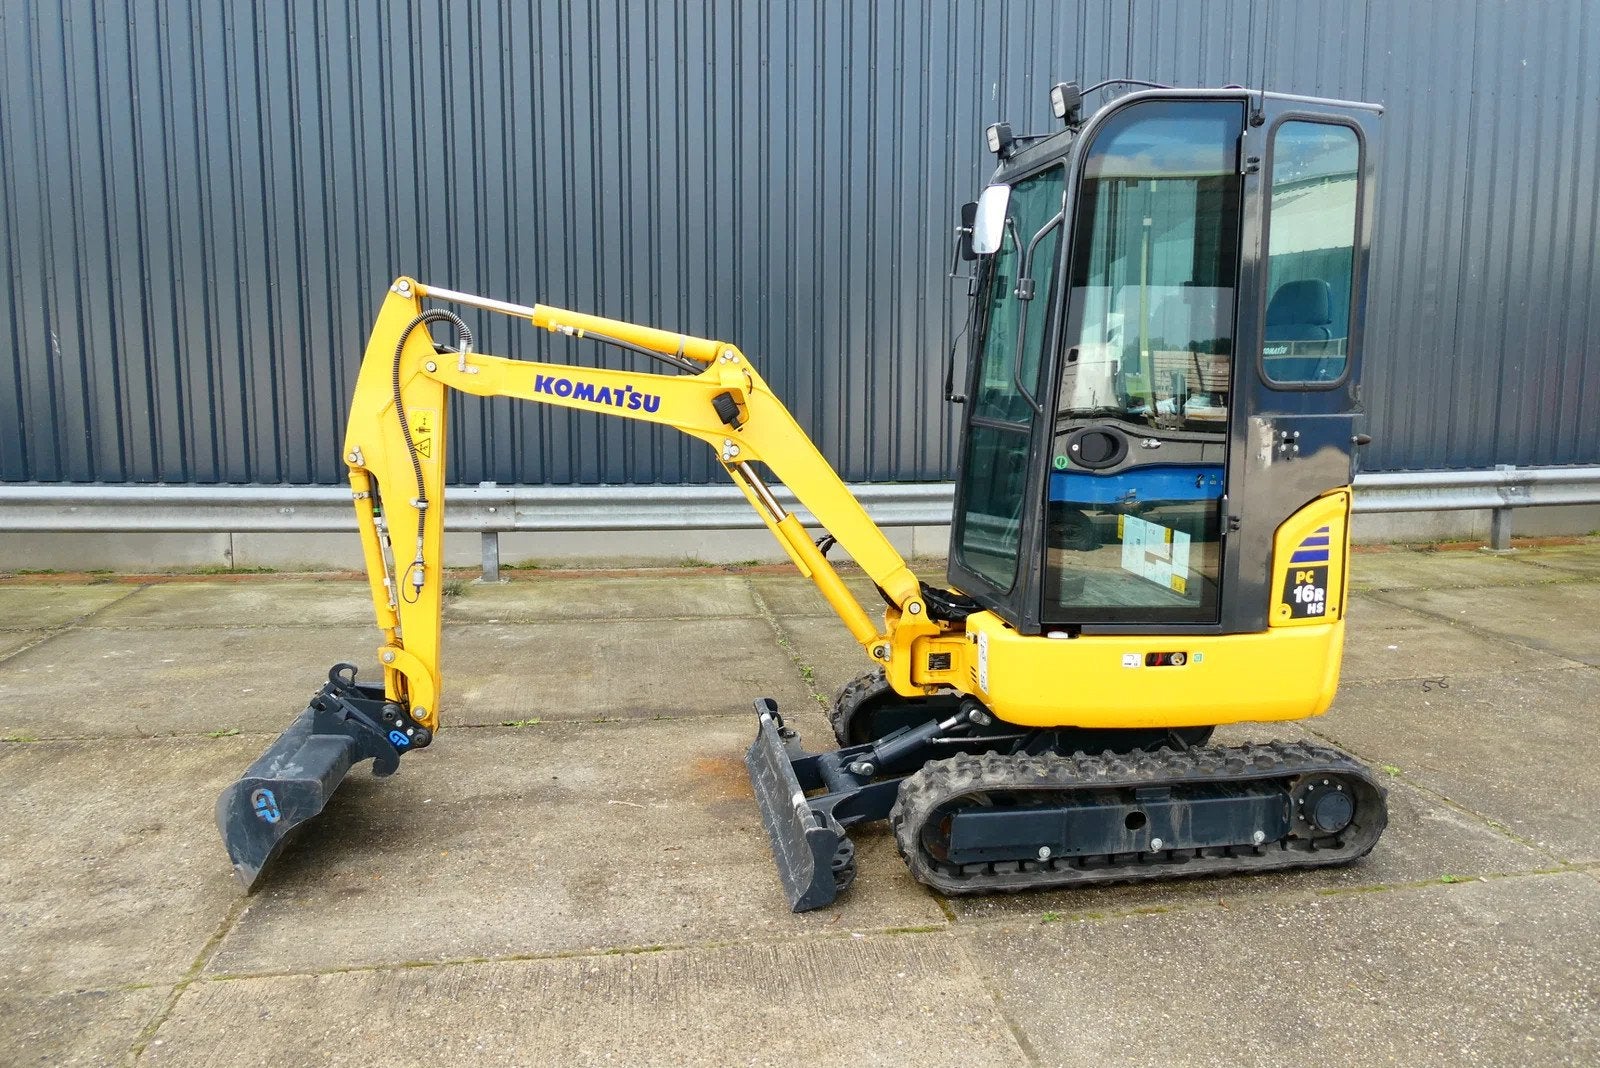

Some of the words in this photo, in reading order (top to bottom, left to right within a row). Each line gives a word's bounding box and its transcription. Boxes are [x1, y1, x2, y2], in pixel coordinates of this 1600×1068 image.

[534, 374, 661, 413] KOMATSU
[1295, 570, 1314, 584] PC
[1293, 584, 1325, 603] 16R
[1307, 602, 1324, 615] HS
